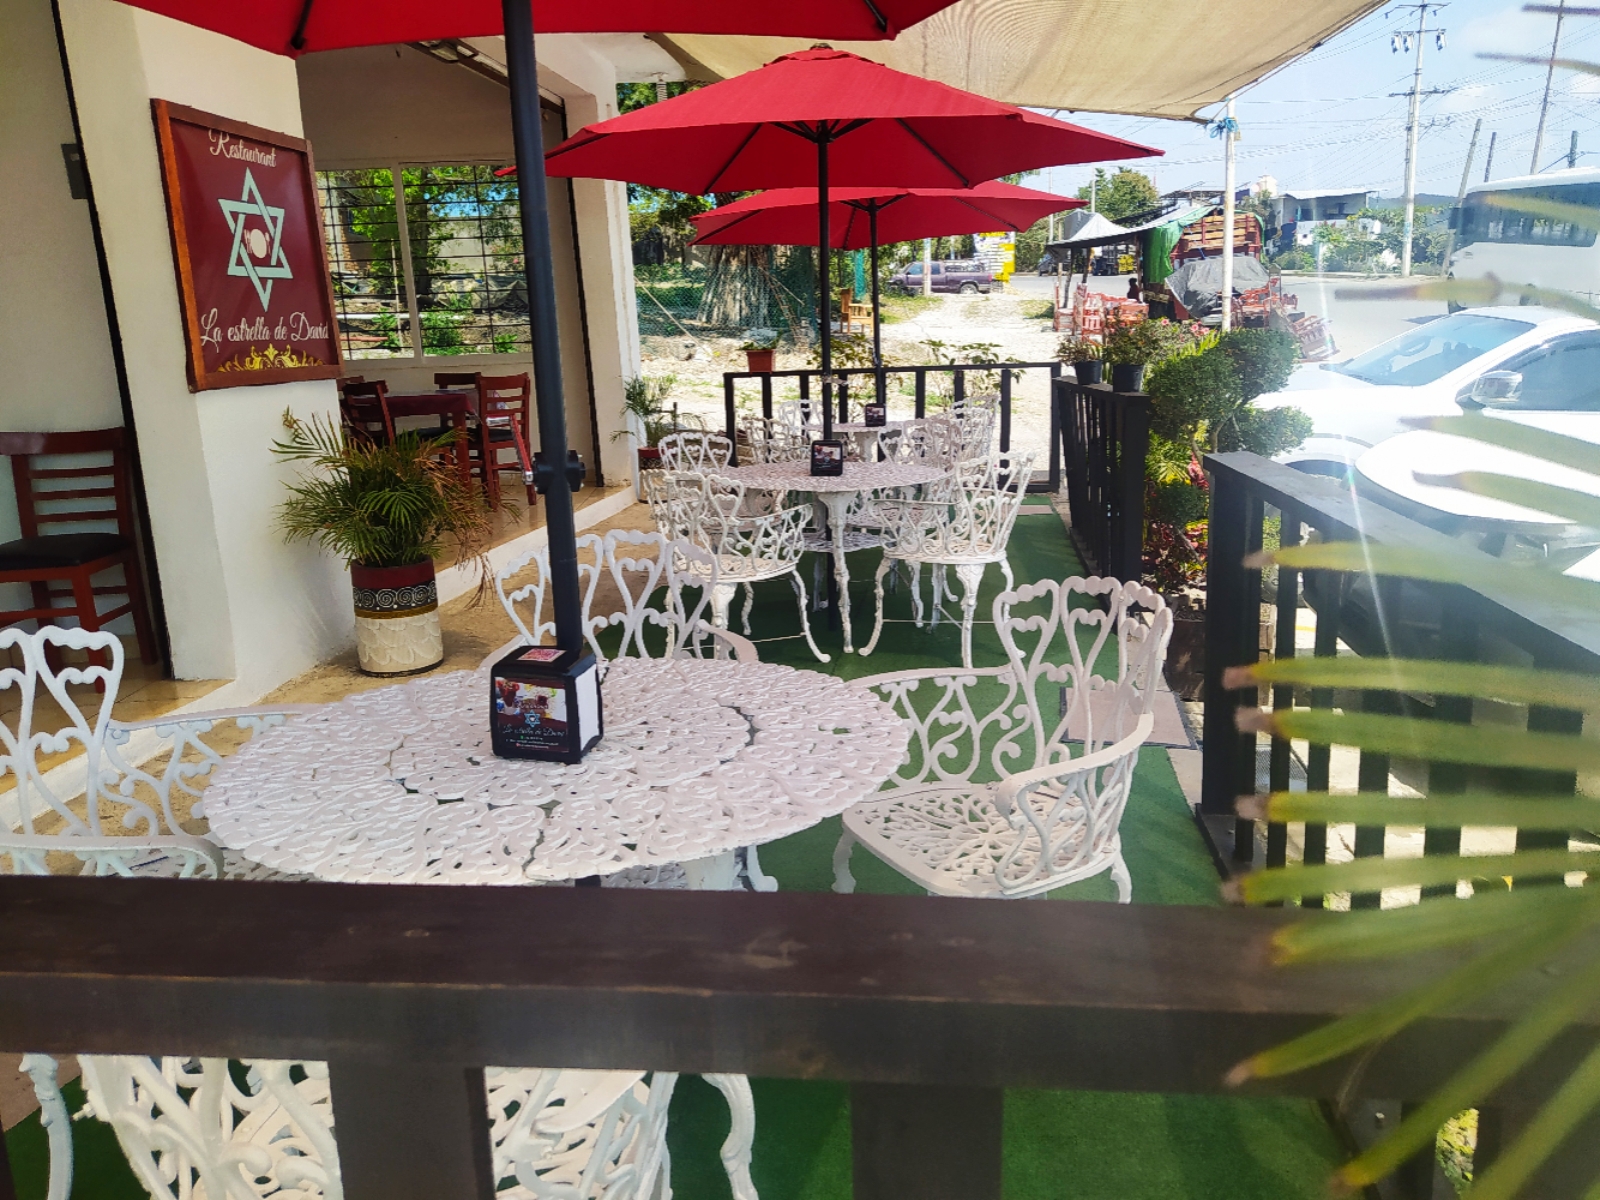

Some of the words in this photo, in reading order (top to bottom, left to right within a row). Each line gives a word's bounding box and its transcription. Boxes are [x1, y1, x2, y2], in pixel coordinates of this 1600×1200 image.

[208, 129, 277, 167] Restaurant
[200, 308, 223, 353] La
[227, 317, 271, 342] estrella
[274, 316, 288, 341] de
[289, 311, 329, 342] David
